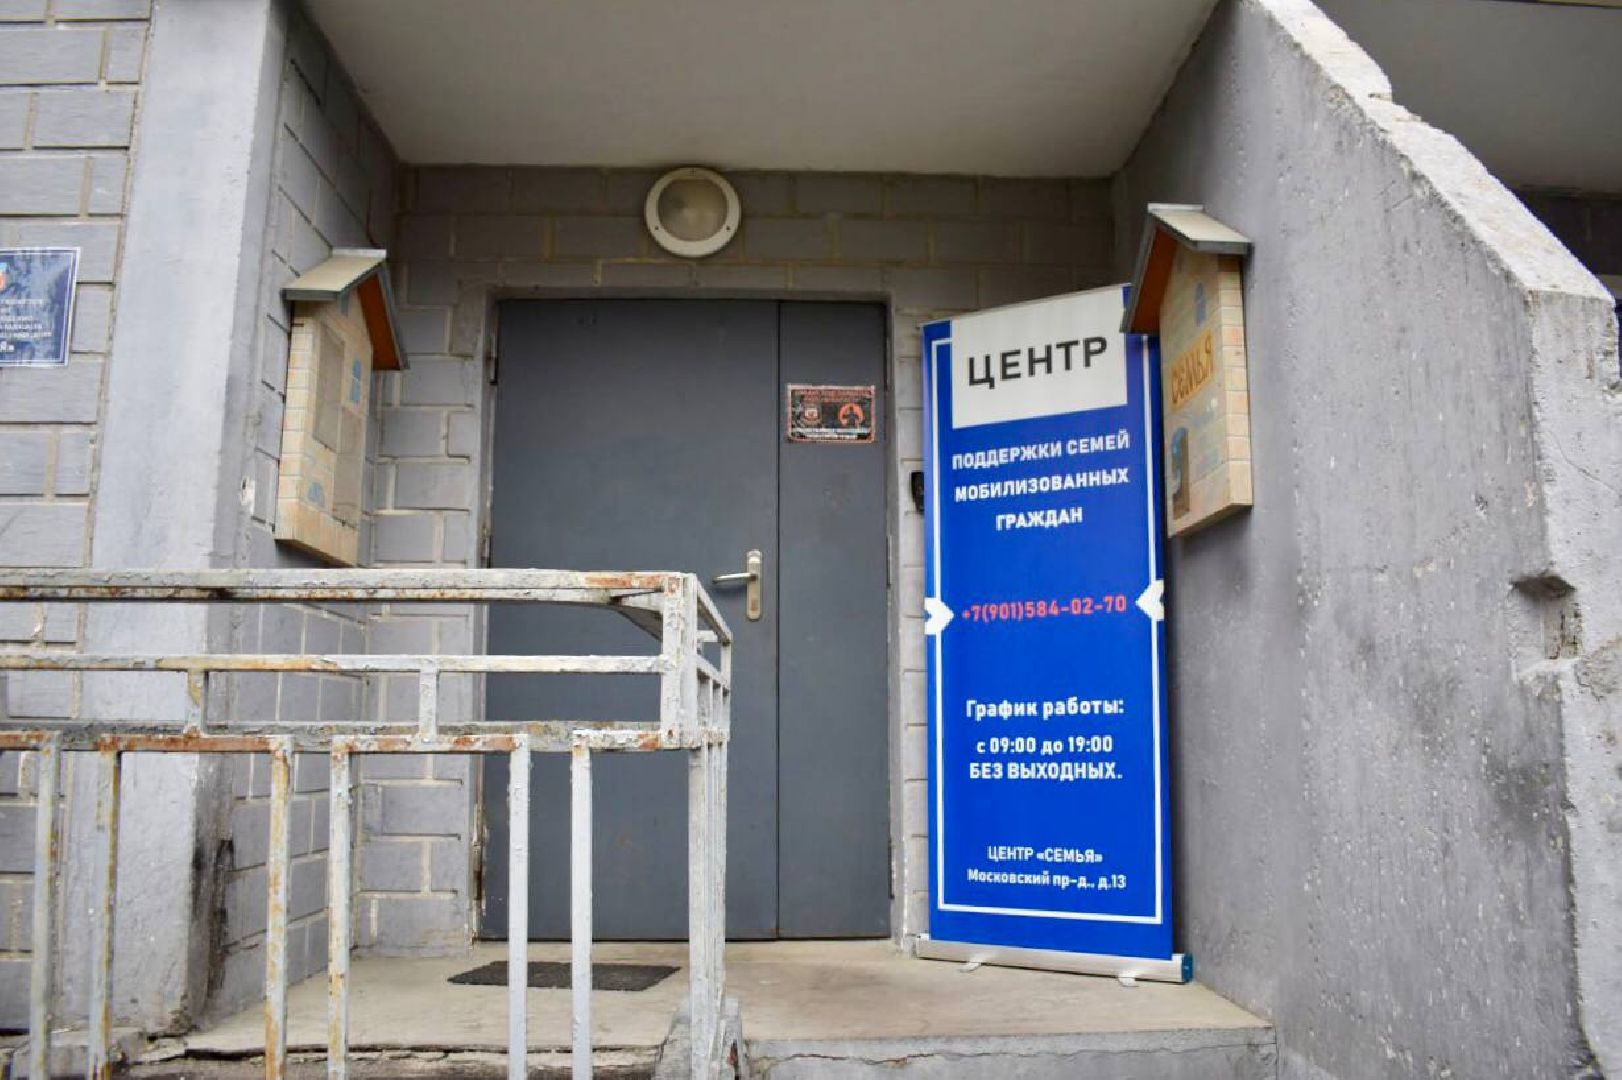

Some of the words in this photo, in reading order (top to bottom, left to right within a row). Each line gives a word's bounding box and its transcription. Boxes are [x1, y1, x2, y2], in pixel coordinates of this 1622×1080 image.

[968, 336, 1107, 389] ЦЕНТР
[952, 440, 1062, 470] ПОДДЕРЖКИ
[1067, 428, 1130, 454] СЕМЕЙ
[955, 468, 1129, 502] МОБИЛИЗОВАННЫХ
[996, 506, 1083, 531] ГРАЖДАН
[962, 595, 1127, 623] +7(901)584-02-70
[965, 699, 1038, 722] График
[1042, 696, 1125, 721] работы:
[976, 741, 986, 753] с
[989, 737, 1036, 753] 09:00
[1040, 741, 1064, 756] до
[1068, 735, 1113, 753] 19:00
[969, 762, 1003, 779] БЕЗ
[1007, 762, 1123, 781] ВЫХОДНЫХ.
[987, 845, 1034, 862] ЦЕНТР
[1036, 847, 1103, 863] «СЕМЬЯ»
[967, 868, 1050, 885] Московский
[1097, 874, 1127, 891] д.13
